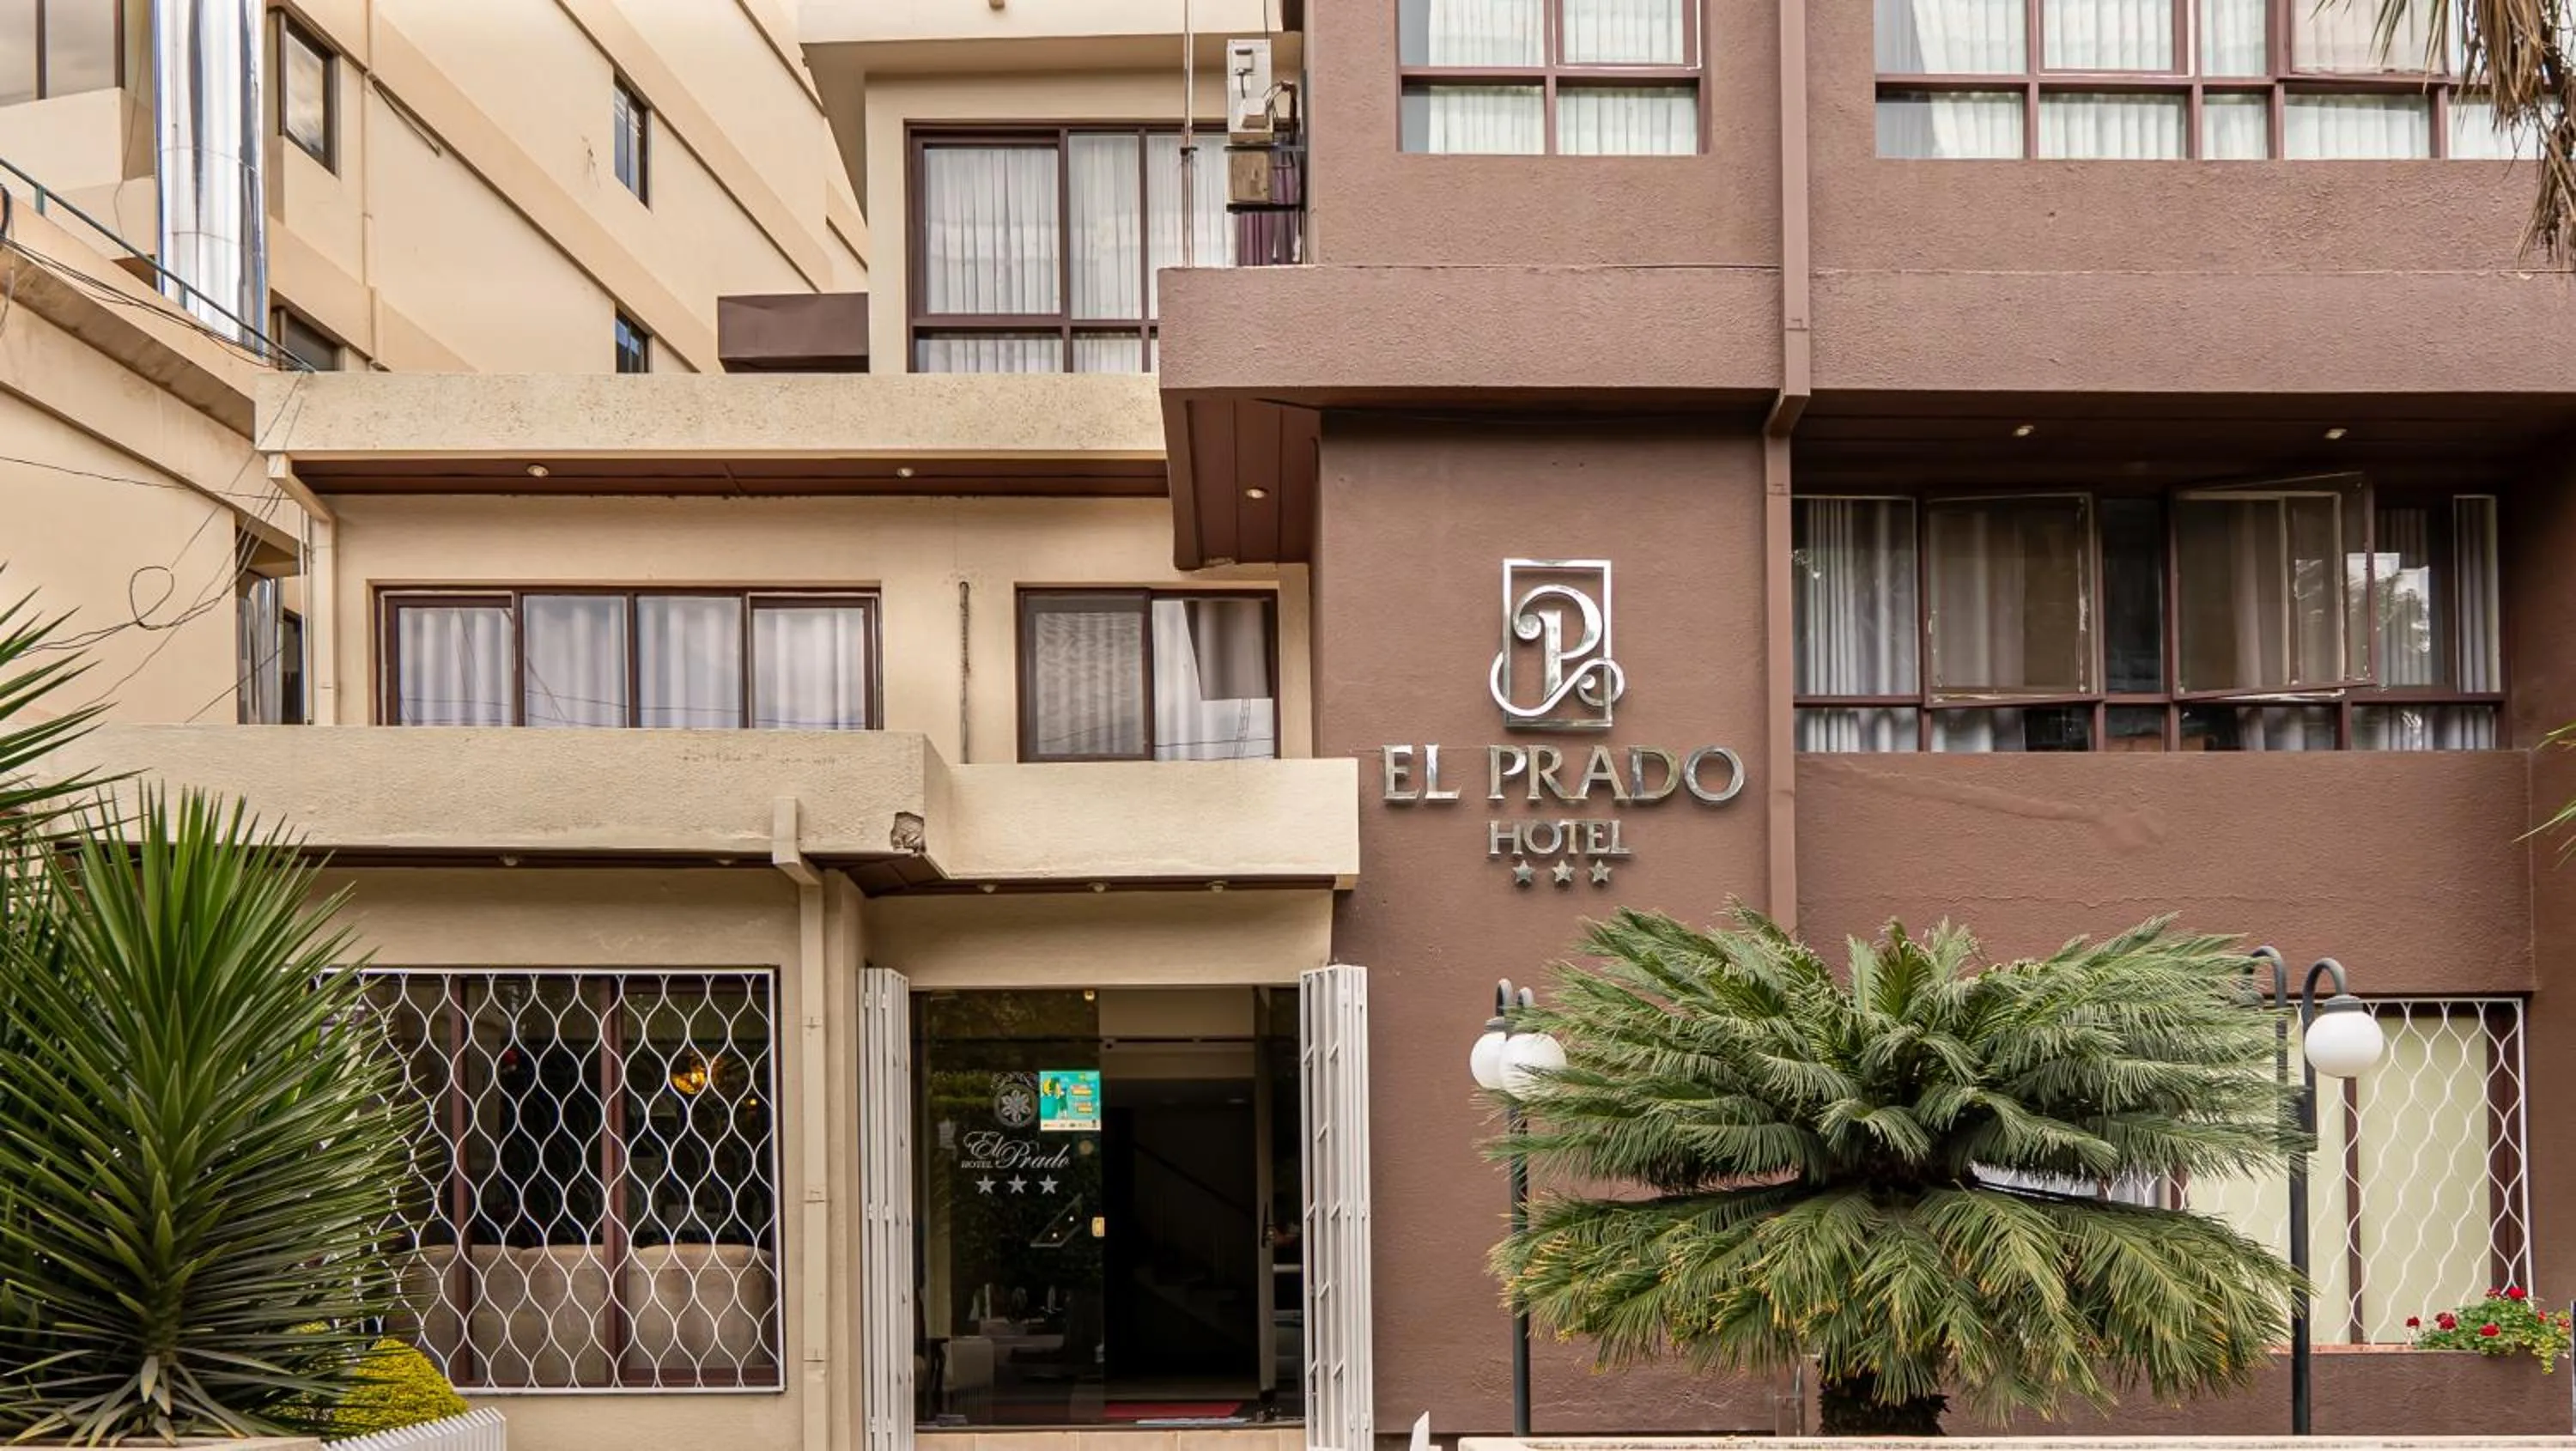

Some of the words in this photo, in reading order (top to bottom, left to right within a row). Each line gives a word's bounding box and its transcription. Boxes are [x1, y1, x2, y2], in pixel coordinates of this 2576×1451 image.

[1381, 744, 1459, 800] EL
[1486, 744, 1745, 802] PRADO
[1487, 818, 1631, 857] HOTEL
[961, 1160, 993, 1169] HOTEL
[963, 1131, 1003, 1159] El
[996, 1139, 1069, 1169] Prado
